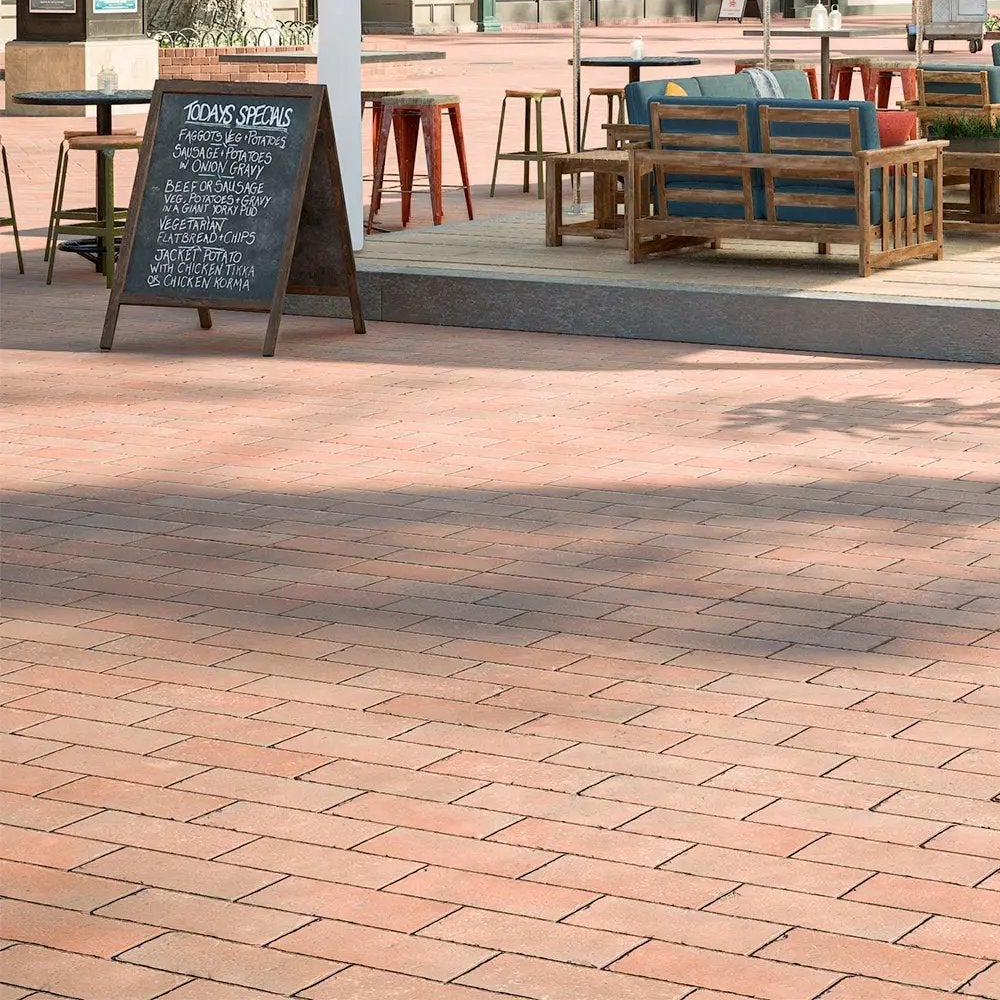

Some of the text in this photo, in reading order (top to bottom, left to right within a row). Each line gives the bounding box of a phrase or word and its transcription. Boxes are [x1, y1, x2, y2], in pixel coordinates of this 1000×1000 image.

[236, 104, 293, 128] SPECIALS
[178, 128, 223, 144] FAGGOTS
[224, 129, 242, 144] VEG
[172, 143, 220, 160] SAUSAGE
[191, 158, 229, 174] ONION
[229, 161, 265, 180] GRAVY
[164, 179, 265, 194] BEEF OR SAUSAGE
[188, 192, 234, 206] POTATOES
[240, 195, 272, 209] GRAVY
[181, 203, 210, 215] GIANT
[240, 206, 258, 217] PUD
[159, 216, 225, 232] VEGETARIAN
[157, 231, 218, 245] FLATBREAD
[223, 231, 257, 245] CHIPS
[154, 248, 242, 264] JACKET POTATO
[149, 262, 255, 278] WITH CHICKEN TIKKA
[163, 273, 212, 289] CHICKEN
[213, 276, 250, 292] KORMA
